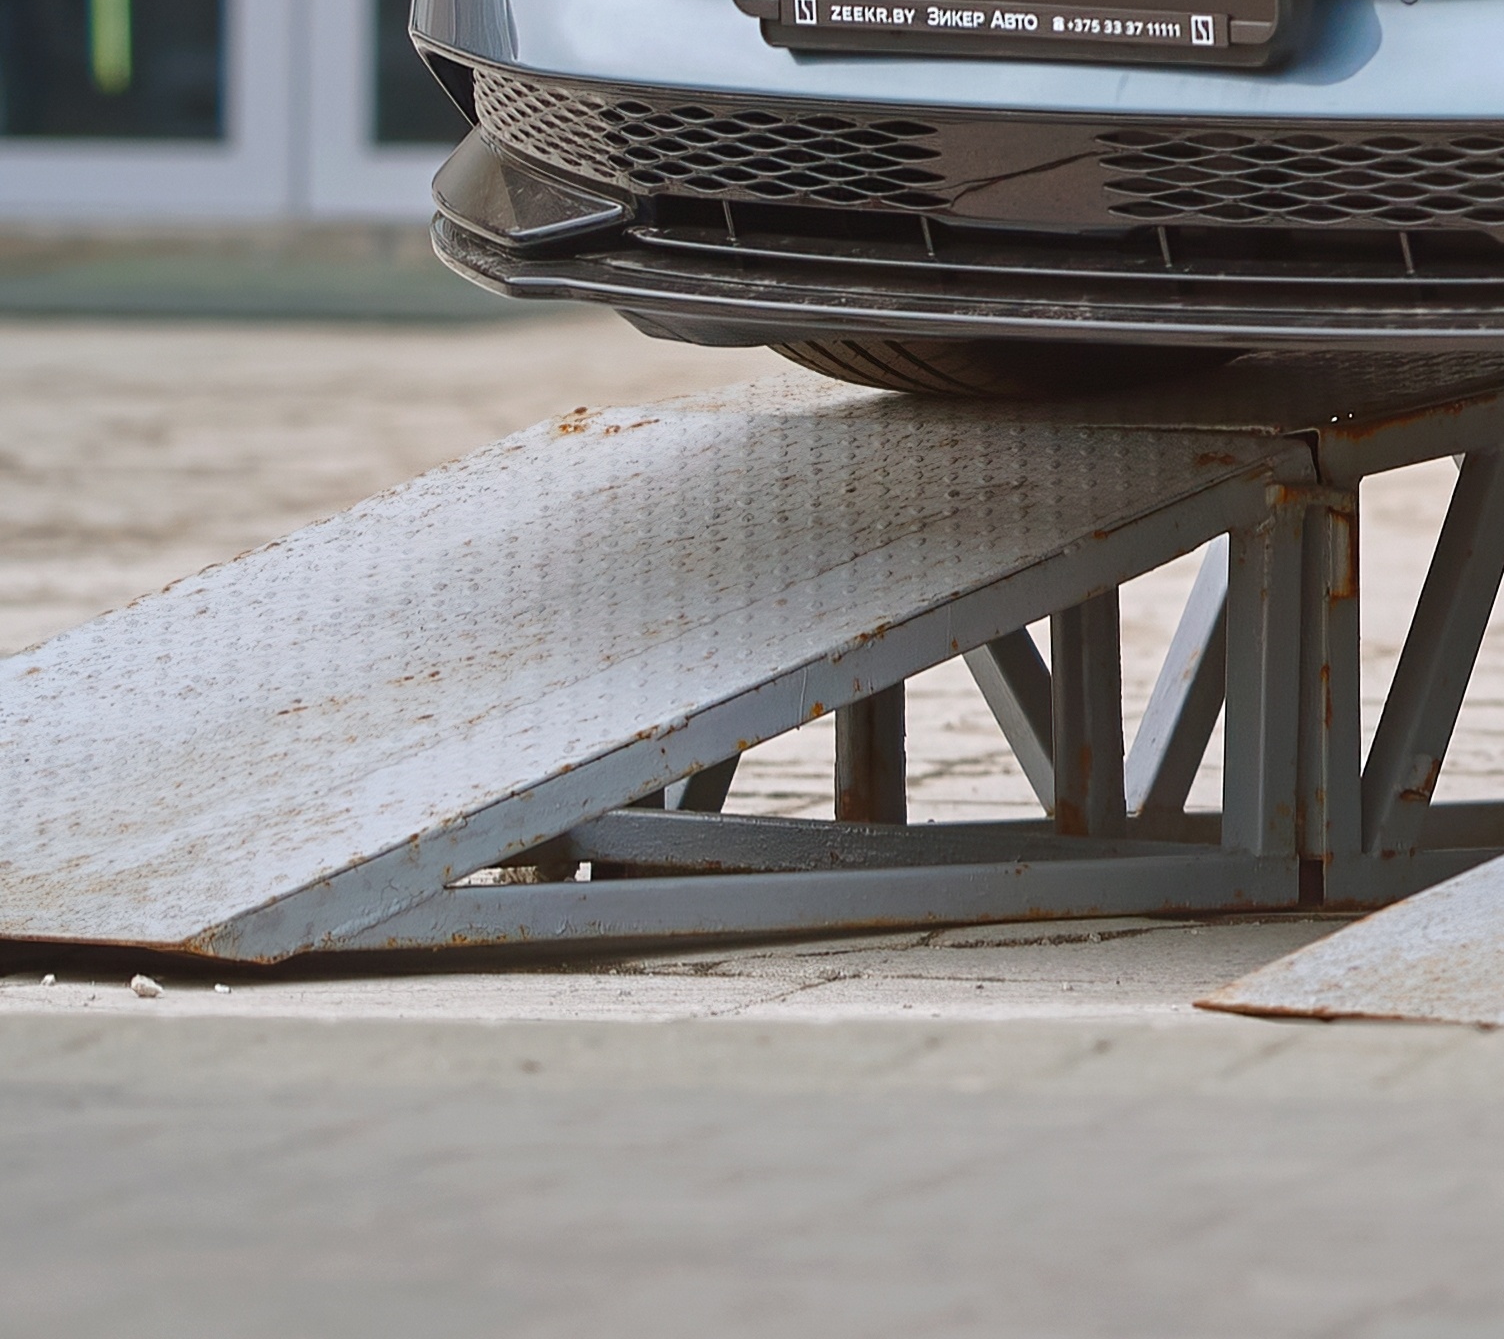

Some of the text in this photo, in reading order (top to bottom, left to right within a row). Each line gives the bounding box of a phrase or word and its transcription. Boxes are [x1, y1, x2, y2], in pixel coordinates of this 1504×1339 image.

[830, 5, 915, 25] ZEEKR.BY
[1103, 19, 1122, 35] 33
[1124, 20, 1144, 36] 37
[1146, 21, 1182, 38] 11111
